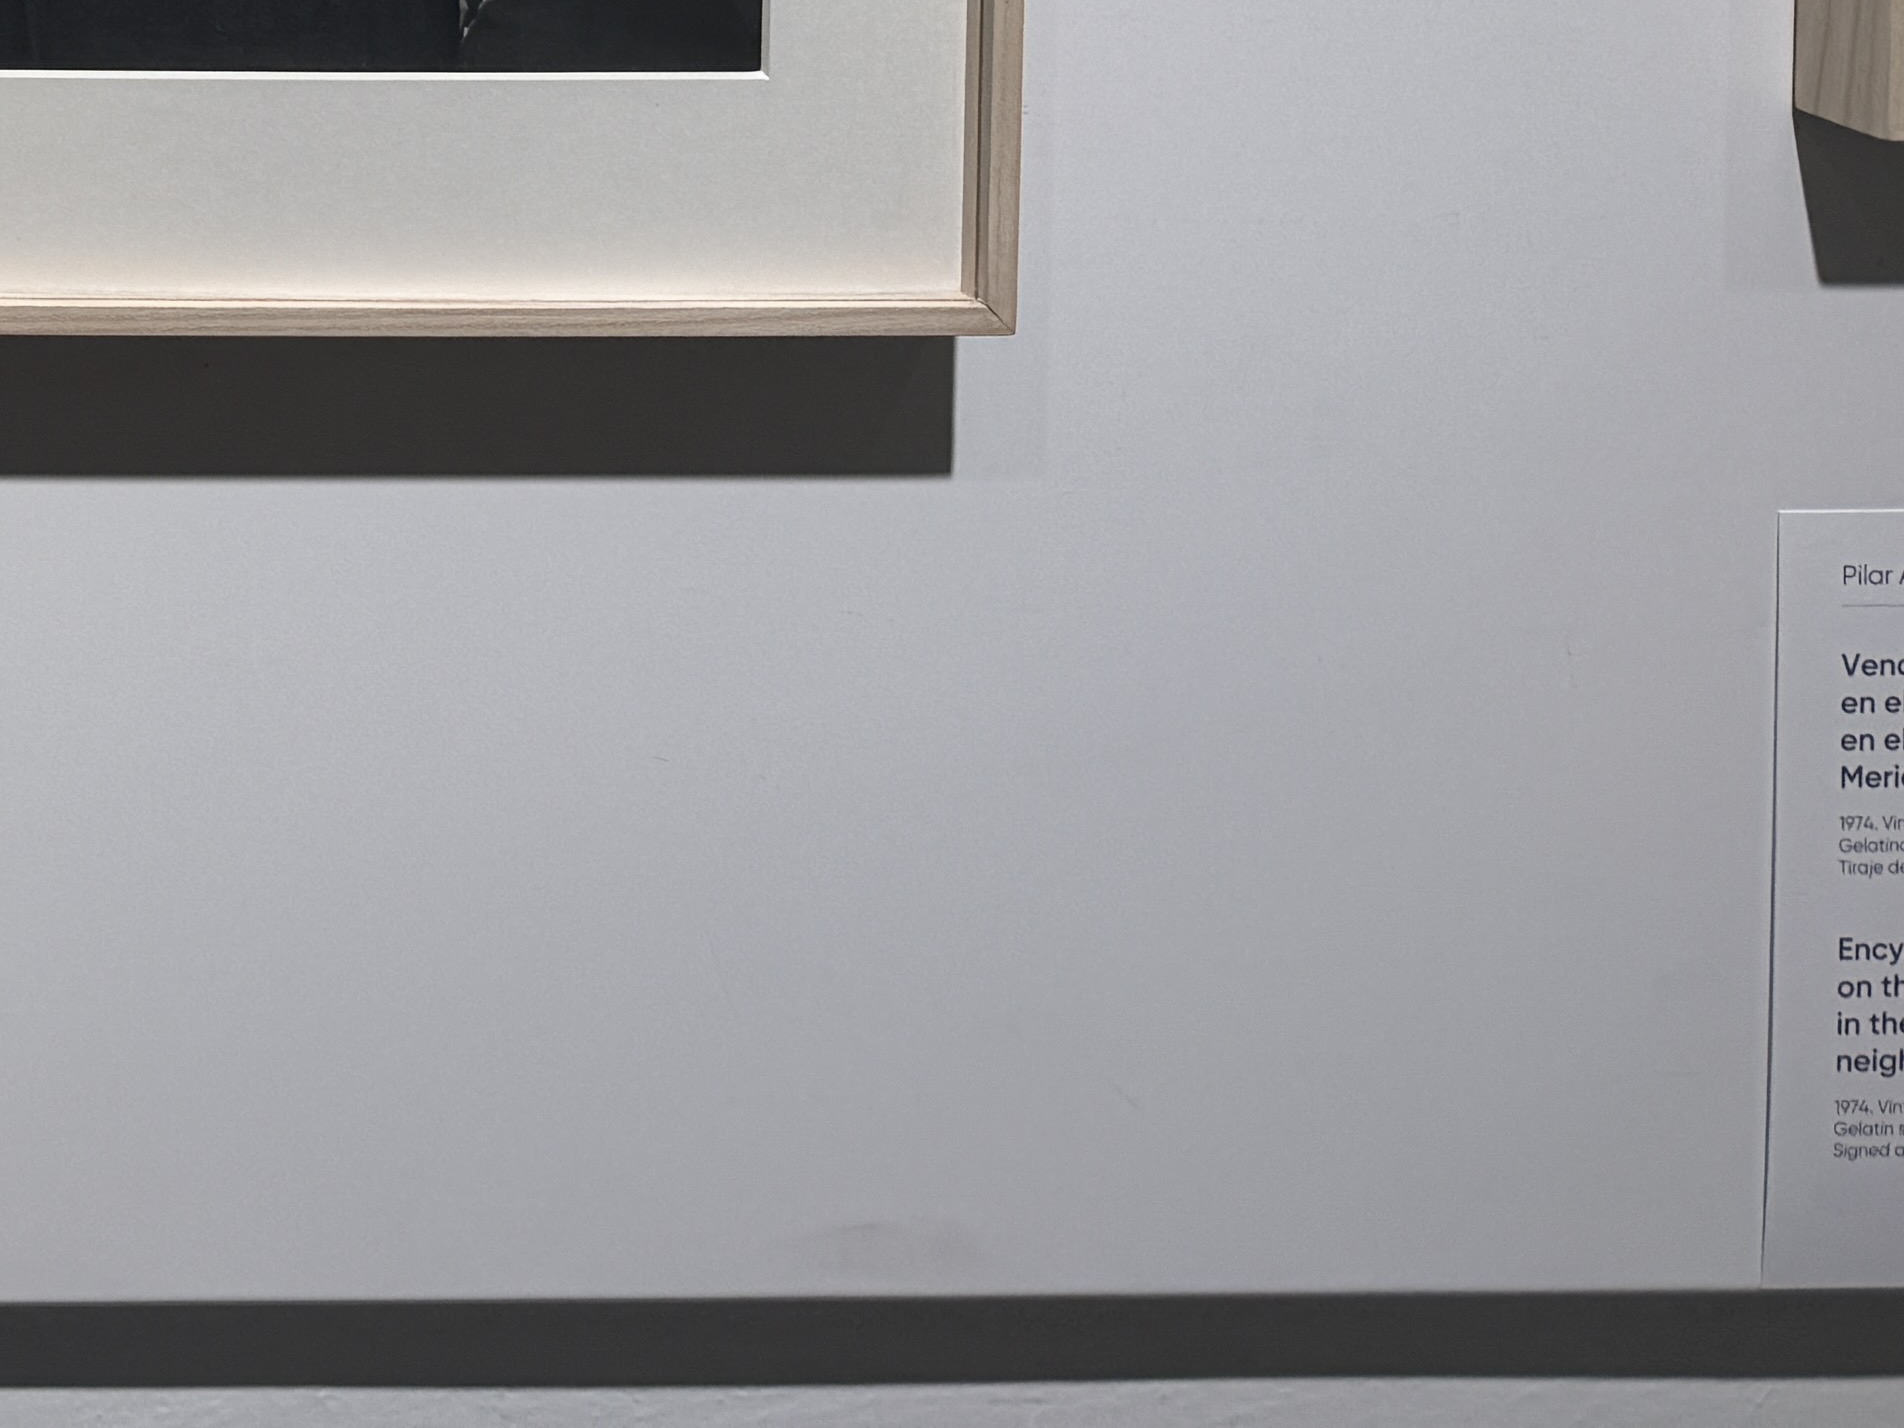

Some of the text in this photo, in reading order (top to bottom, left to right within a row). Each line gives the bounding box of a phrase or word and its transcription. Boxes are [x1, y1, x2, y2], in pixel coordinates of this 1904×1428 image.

[1843, 564, 1893, 585] Pilar
[1842, 653, 1904, 676] Ven
[1841, 697, 1875, 714] en
[1841, 734, 1874, 751] en
[1841, 764, 1904, 789] Meri
[1840, 815, 1878, 831] 1974.
[1838, 860, 1883, 879] Tiraje
[1838, 980, 1872, 998] on
[1838, 1011, 1860, 1035] in
[1835, 1099, 1873, 1115] 1974.
[1834, 1121, 1894, 1136] Gelatin
[1833, 1142, 1891, 1161] Signed
